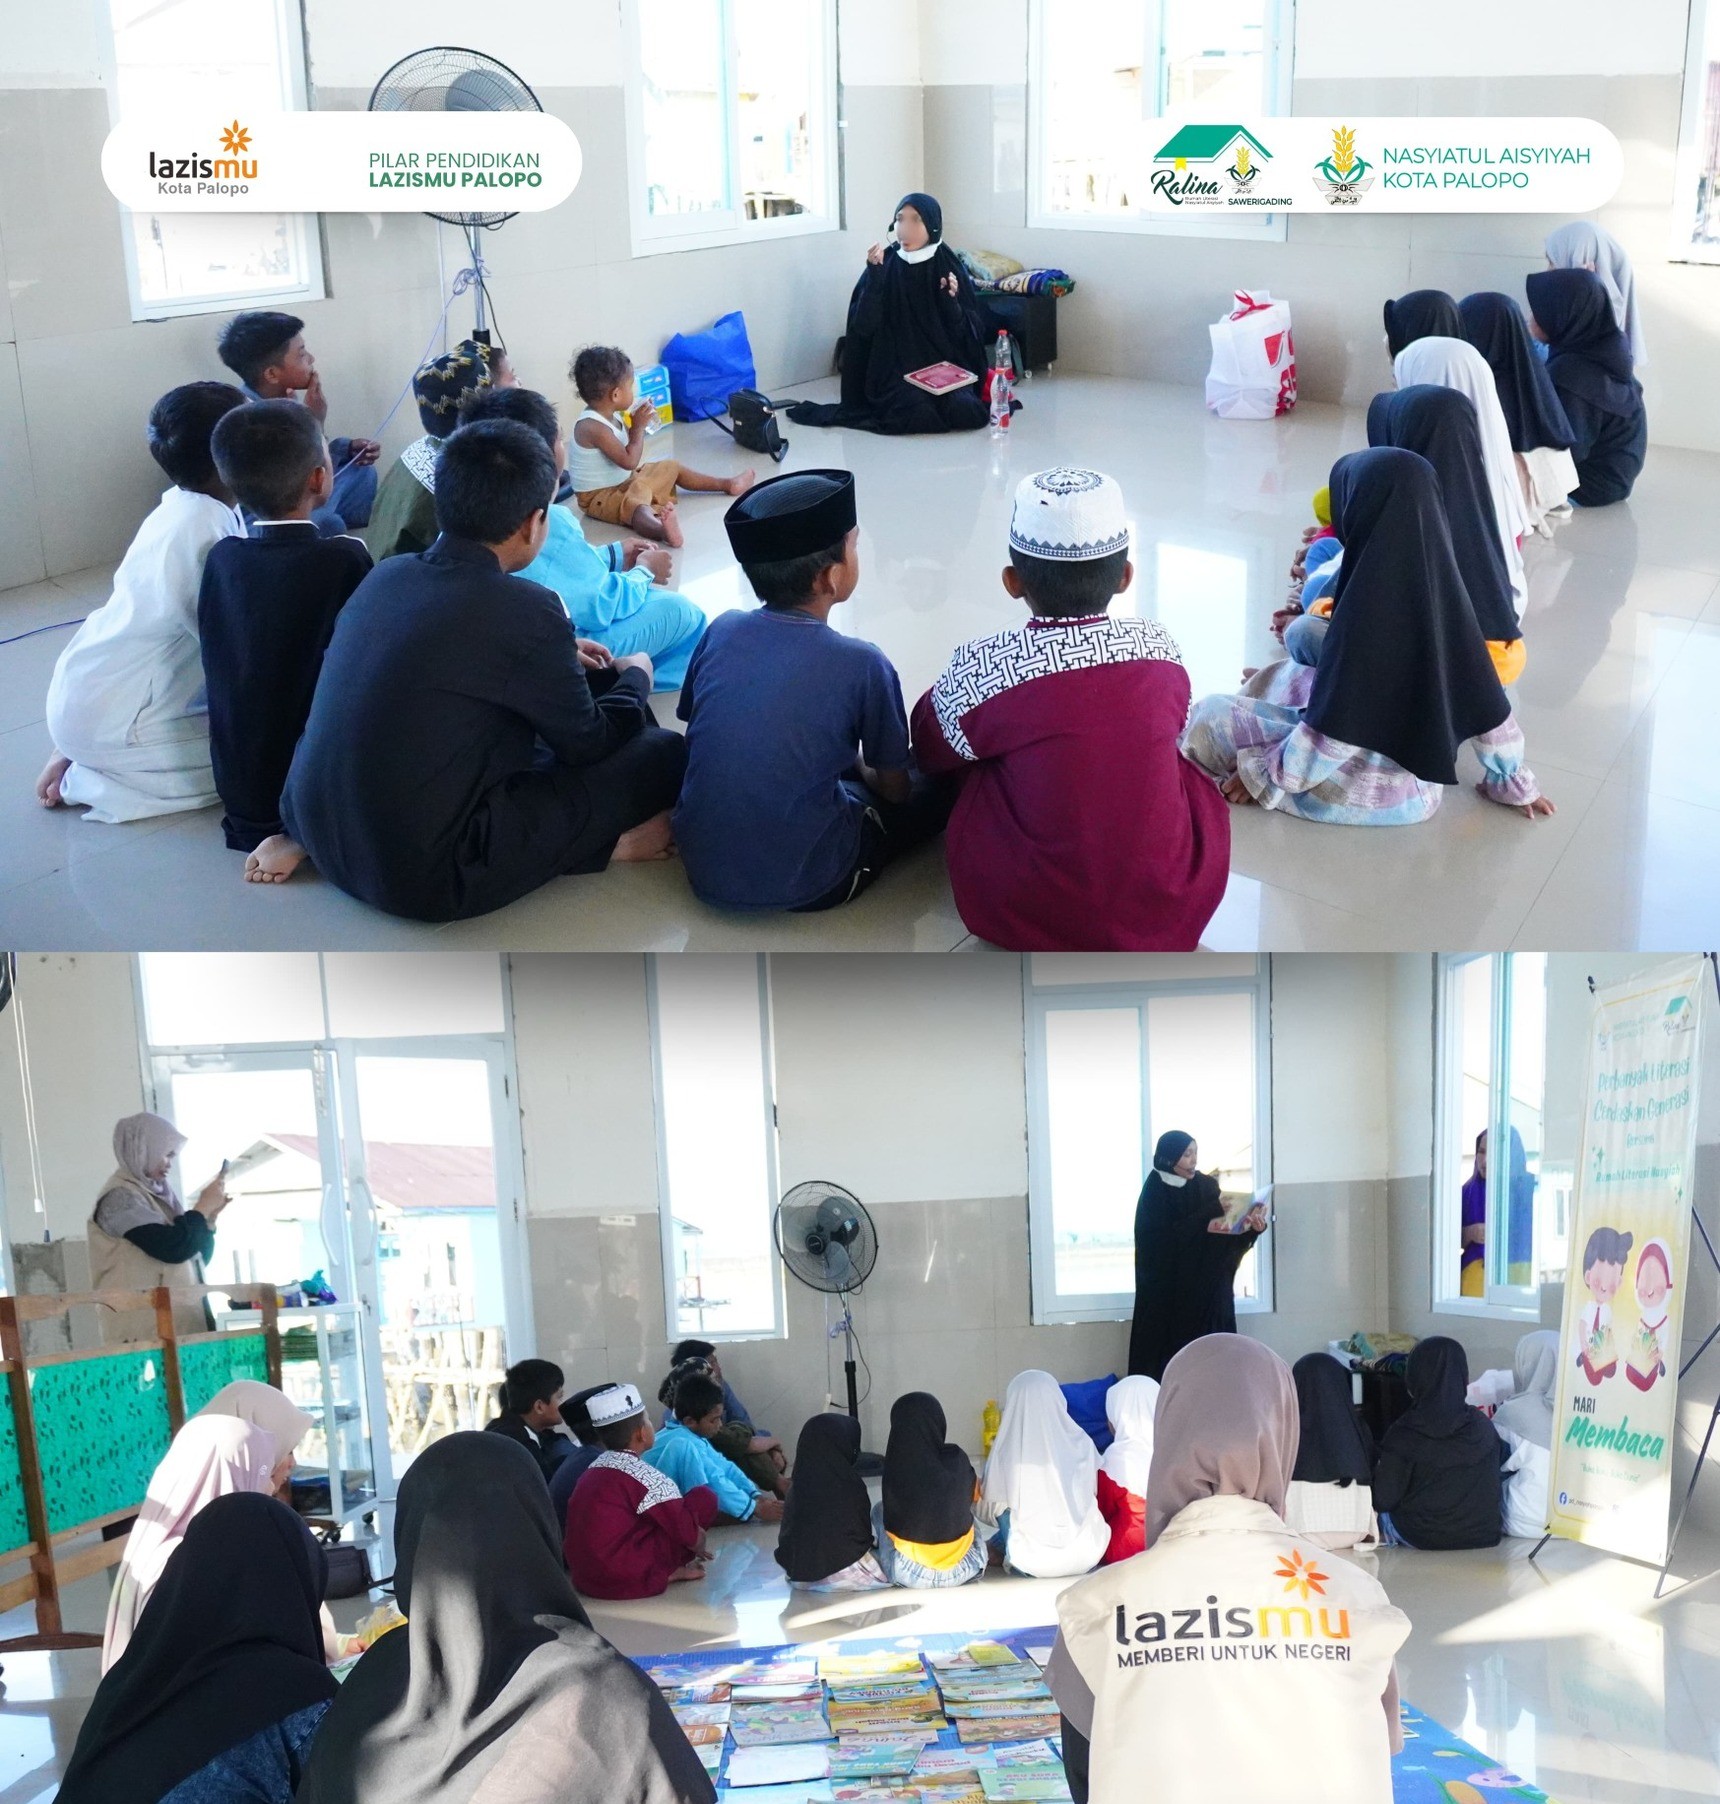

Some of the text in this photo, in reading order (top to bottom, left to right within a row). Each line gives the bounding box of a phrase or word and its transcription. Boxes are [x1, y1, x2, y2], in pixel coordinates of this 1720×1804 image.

[1650, 1056, 1690, 1081] Literasi
[1647, 1085, 1689, 1119] Generasi
[1621, 1166, 1651, 1181] Literasi
[1573, 1395, 1596, 1414] MARI
[1566, 1416, 1664, 1460] Membaca
[1115, 1594, 1352, 1646] lazismu
[1117, 1644, 1352, 1669] MEMBERI UNTUK NEGERI
